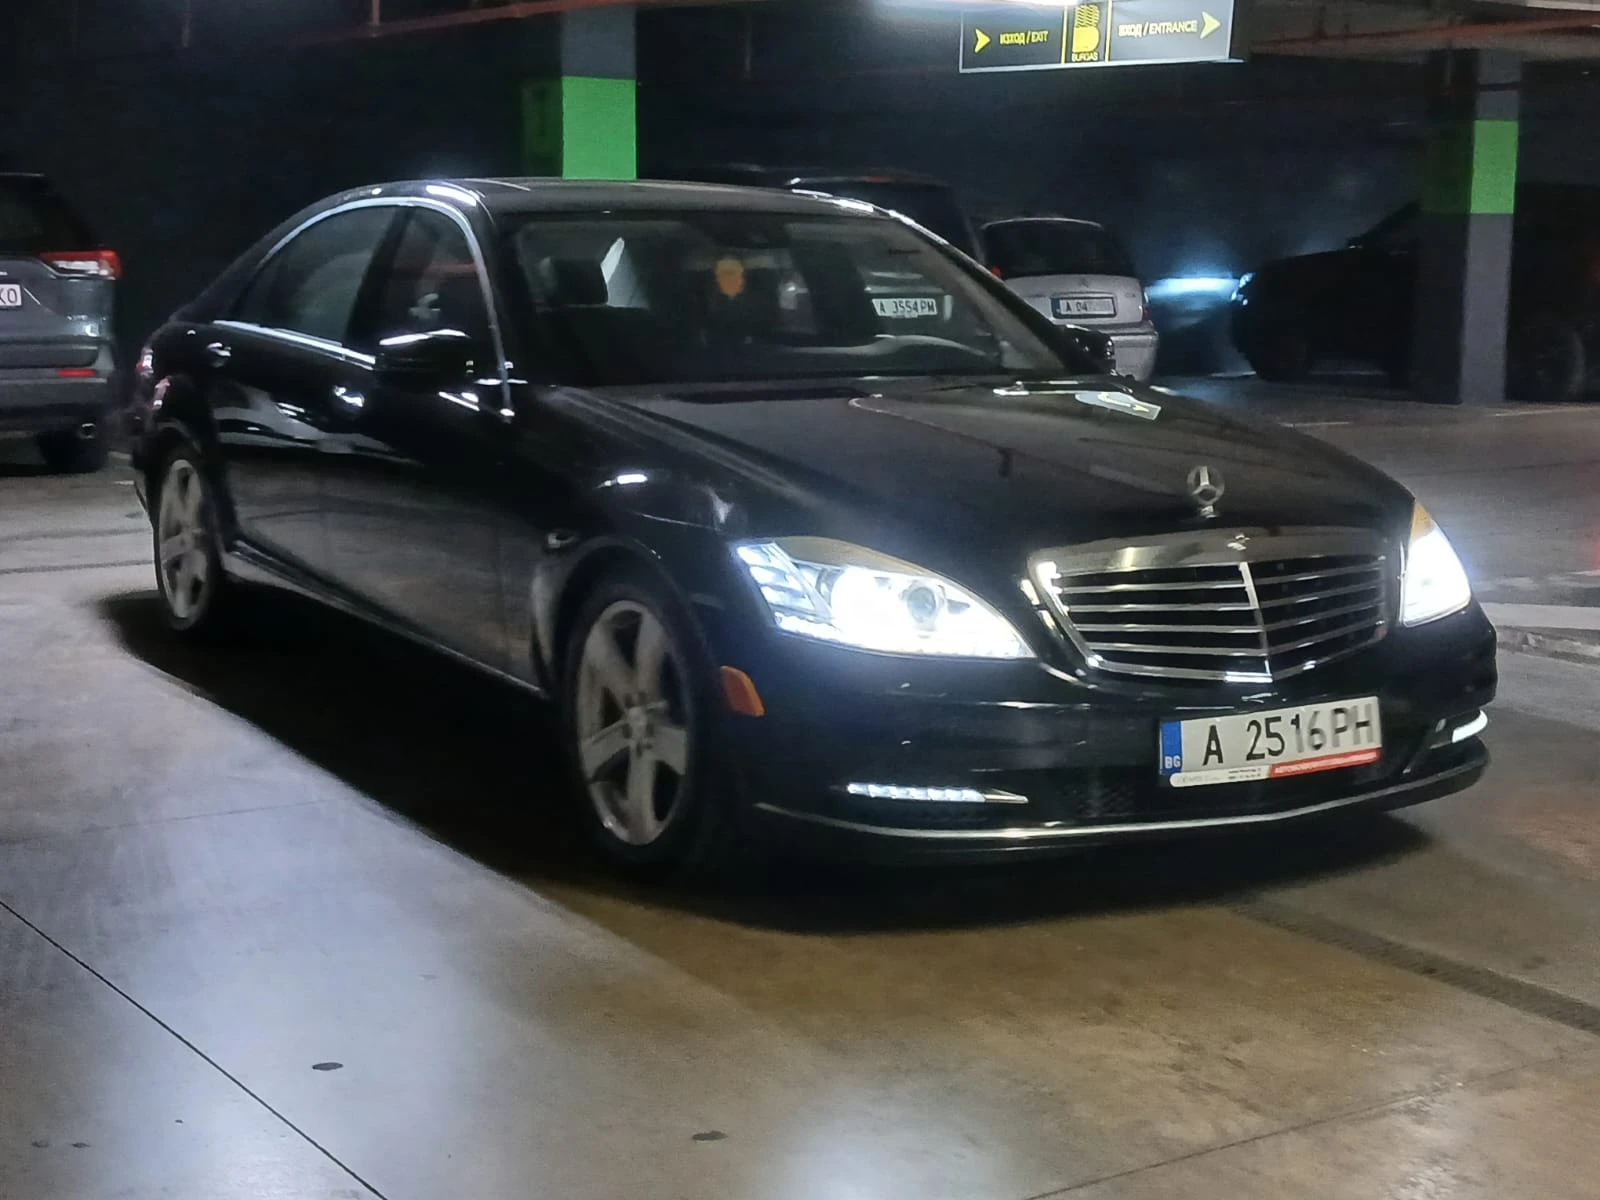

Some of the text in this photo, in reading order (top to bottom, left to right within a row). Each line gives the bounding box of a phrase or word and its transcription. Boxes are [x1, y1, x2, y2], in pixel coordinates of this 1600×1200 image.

[1149, 20, 1197, 35] ENTRANCE
[1072, 51, 1099, 62] BURGAS
[1202, 724, 1224, 766] A
[1164, 755, 1181, 769] BG
